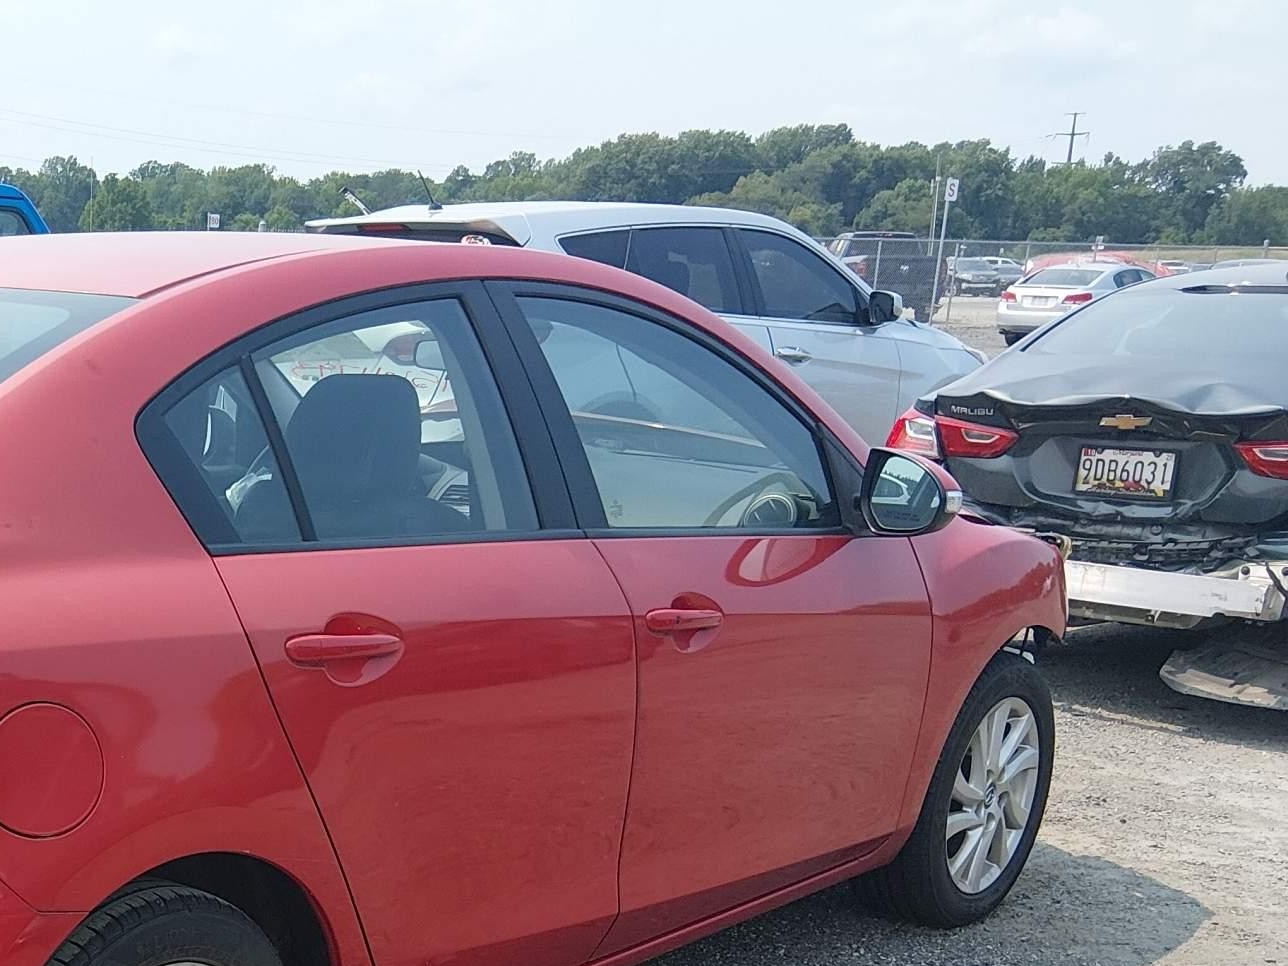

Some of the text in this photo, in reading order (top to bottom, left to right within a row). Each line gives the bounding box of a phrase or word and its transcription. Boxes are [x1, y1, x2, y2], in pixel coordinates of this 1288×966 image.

[948, 182, 956, 198] S
[950, 404, 994, 416] MALIBU
[1081, 458, 1168, 487] 9DB6031
